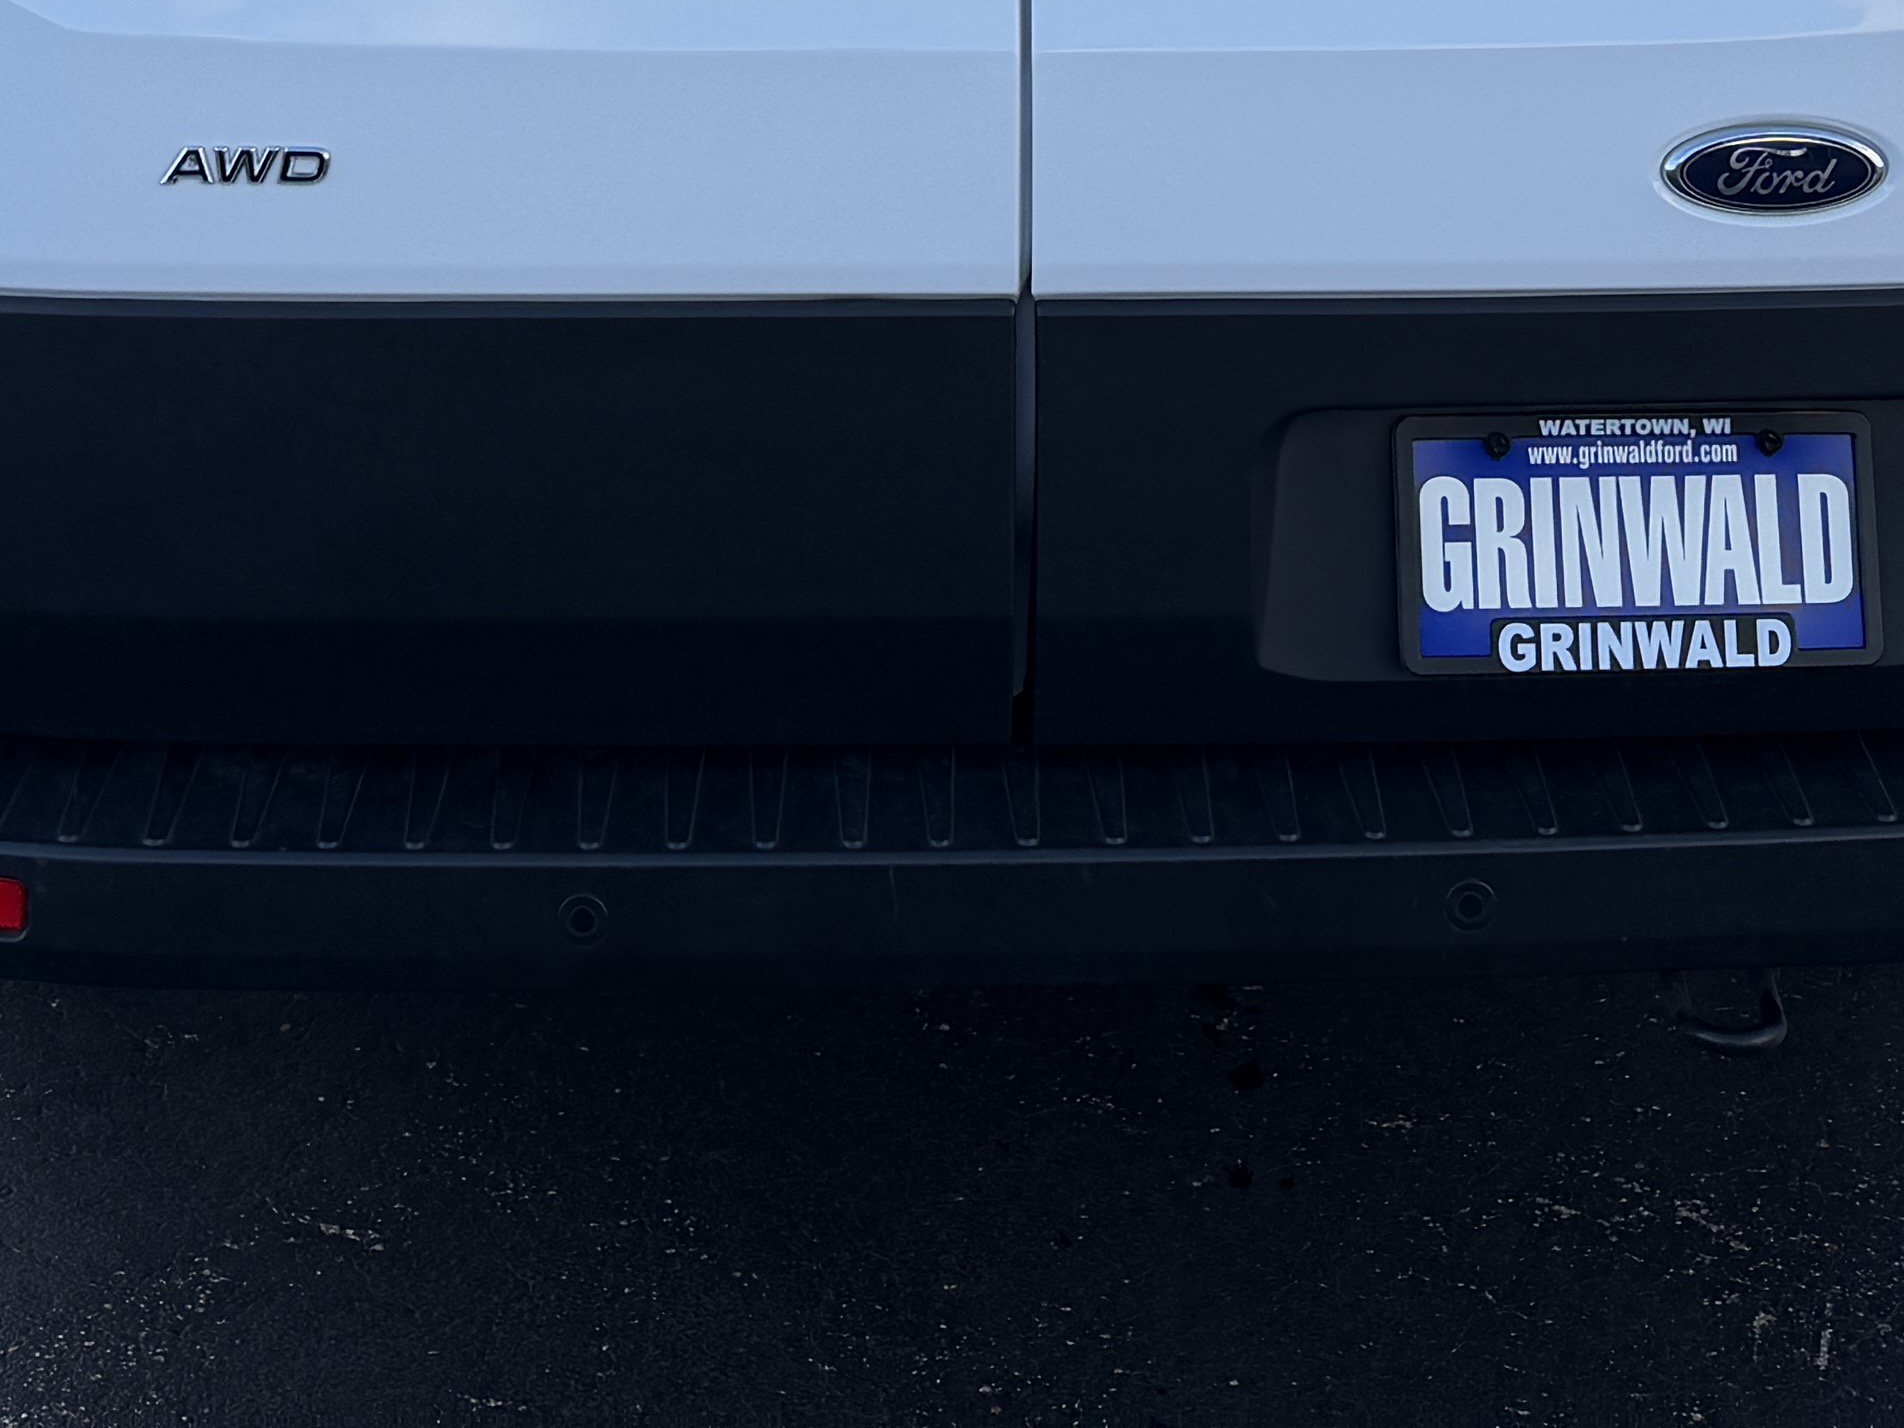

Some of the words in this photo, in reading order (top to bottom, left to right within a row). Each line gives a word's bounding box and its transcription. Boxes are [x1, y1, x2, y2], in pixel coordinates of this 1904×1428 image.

[159, 146, 332, 185] AWD
[1717, 146, 1838, 195] Ford
[1539, 418, 1697, 438] WATERTOWN,
[1702, 417, 1732, 434] WI
[1527, 440, 1738, 469] www.grinwaldford.com
[1418, 473, 1855, 612] GRINWALD
[1498, 618, 1792, 673] GRINWALD
